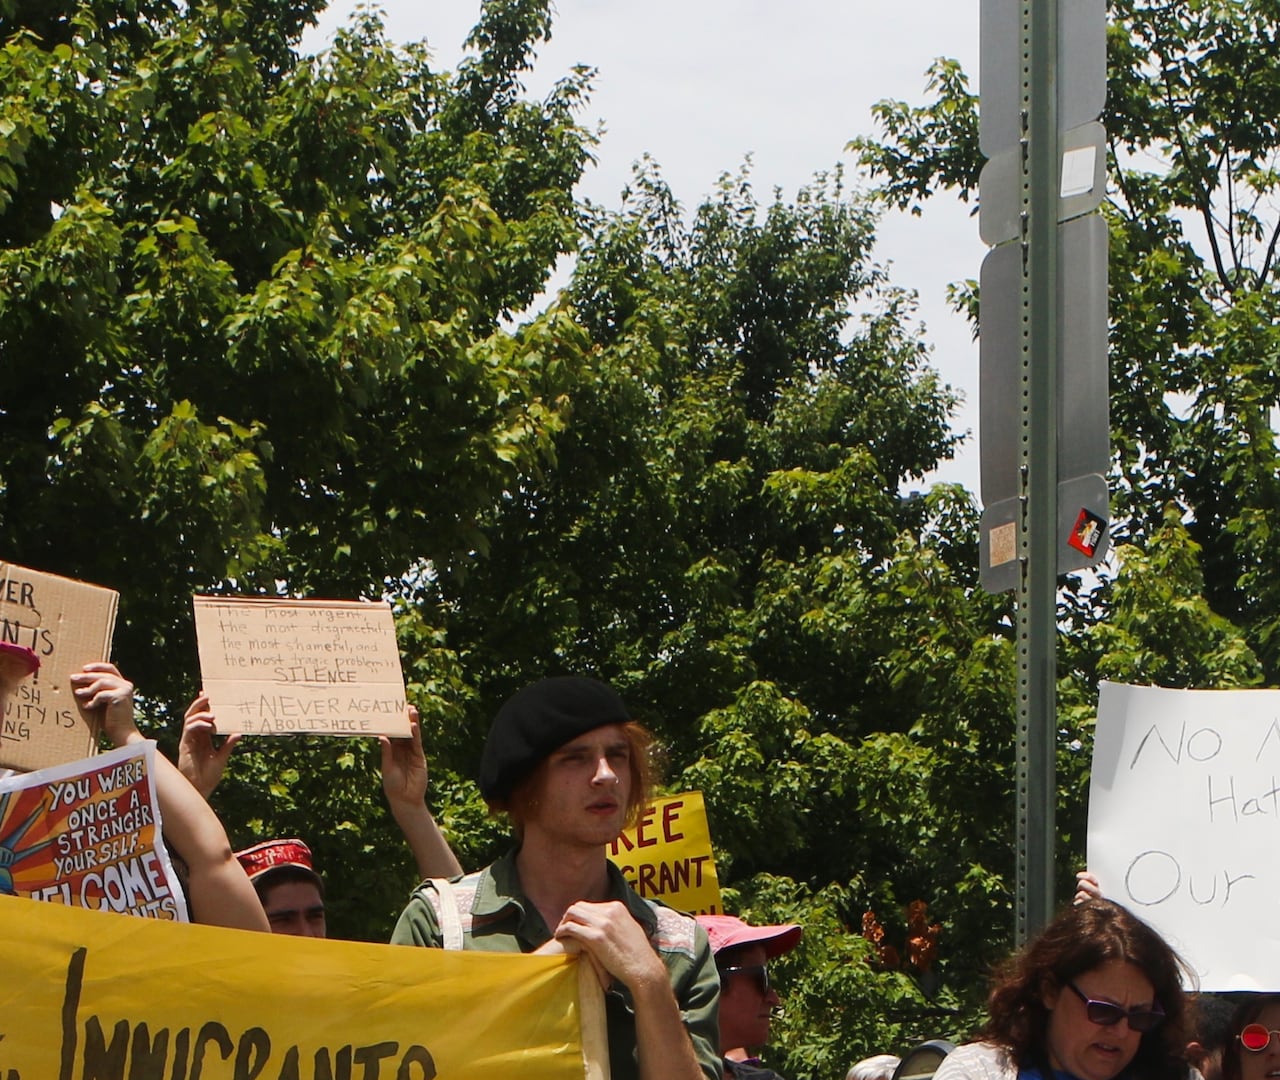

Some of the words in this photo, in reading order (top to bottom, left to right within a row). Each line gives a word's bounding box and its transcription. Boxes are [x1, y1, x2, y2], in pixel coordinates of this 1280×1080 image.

[31, 628, 55, 656] IS
[54, 710, 77, 729] IS
[347, 696, 408, 715] AGAIN
[48, 778, 91, 812] YOU
[97, 759, 145, 794] WERE
[57, 804, 154, 855] STRANGER
[67, 798, 118, 831] ONCE
[129, 789, 140, 809] A
[54, 831, 146, 881] YOURSELF.
[621, 855, 710, 898] GRANT
[1124, 850, 1257, 909] Our
